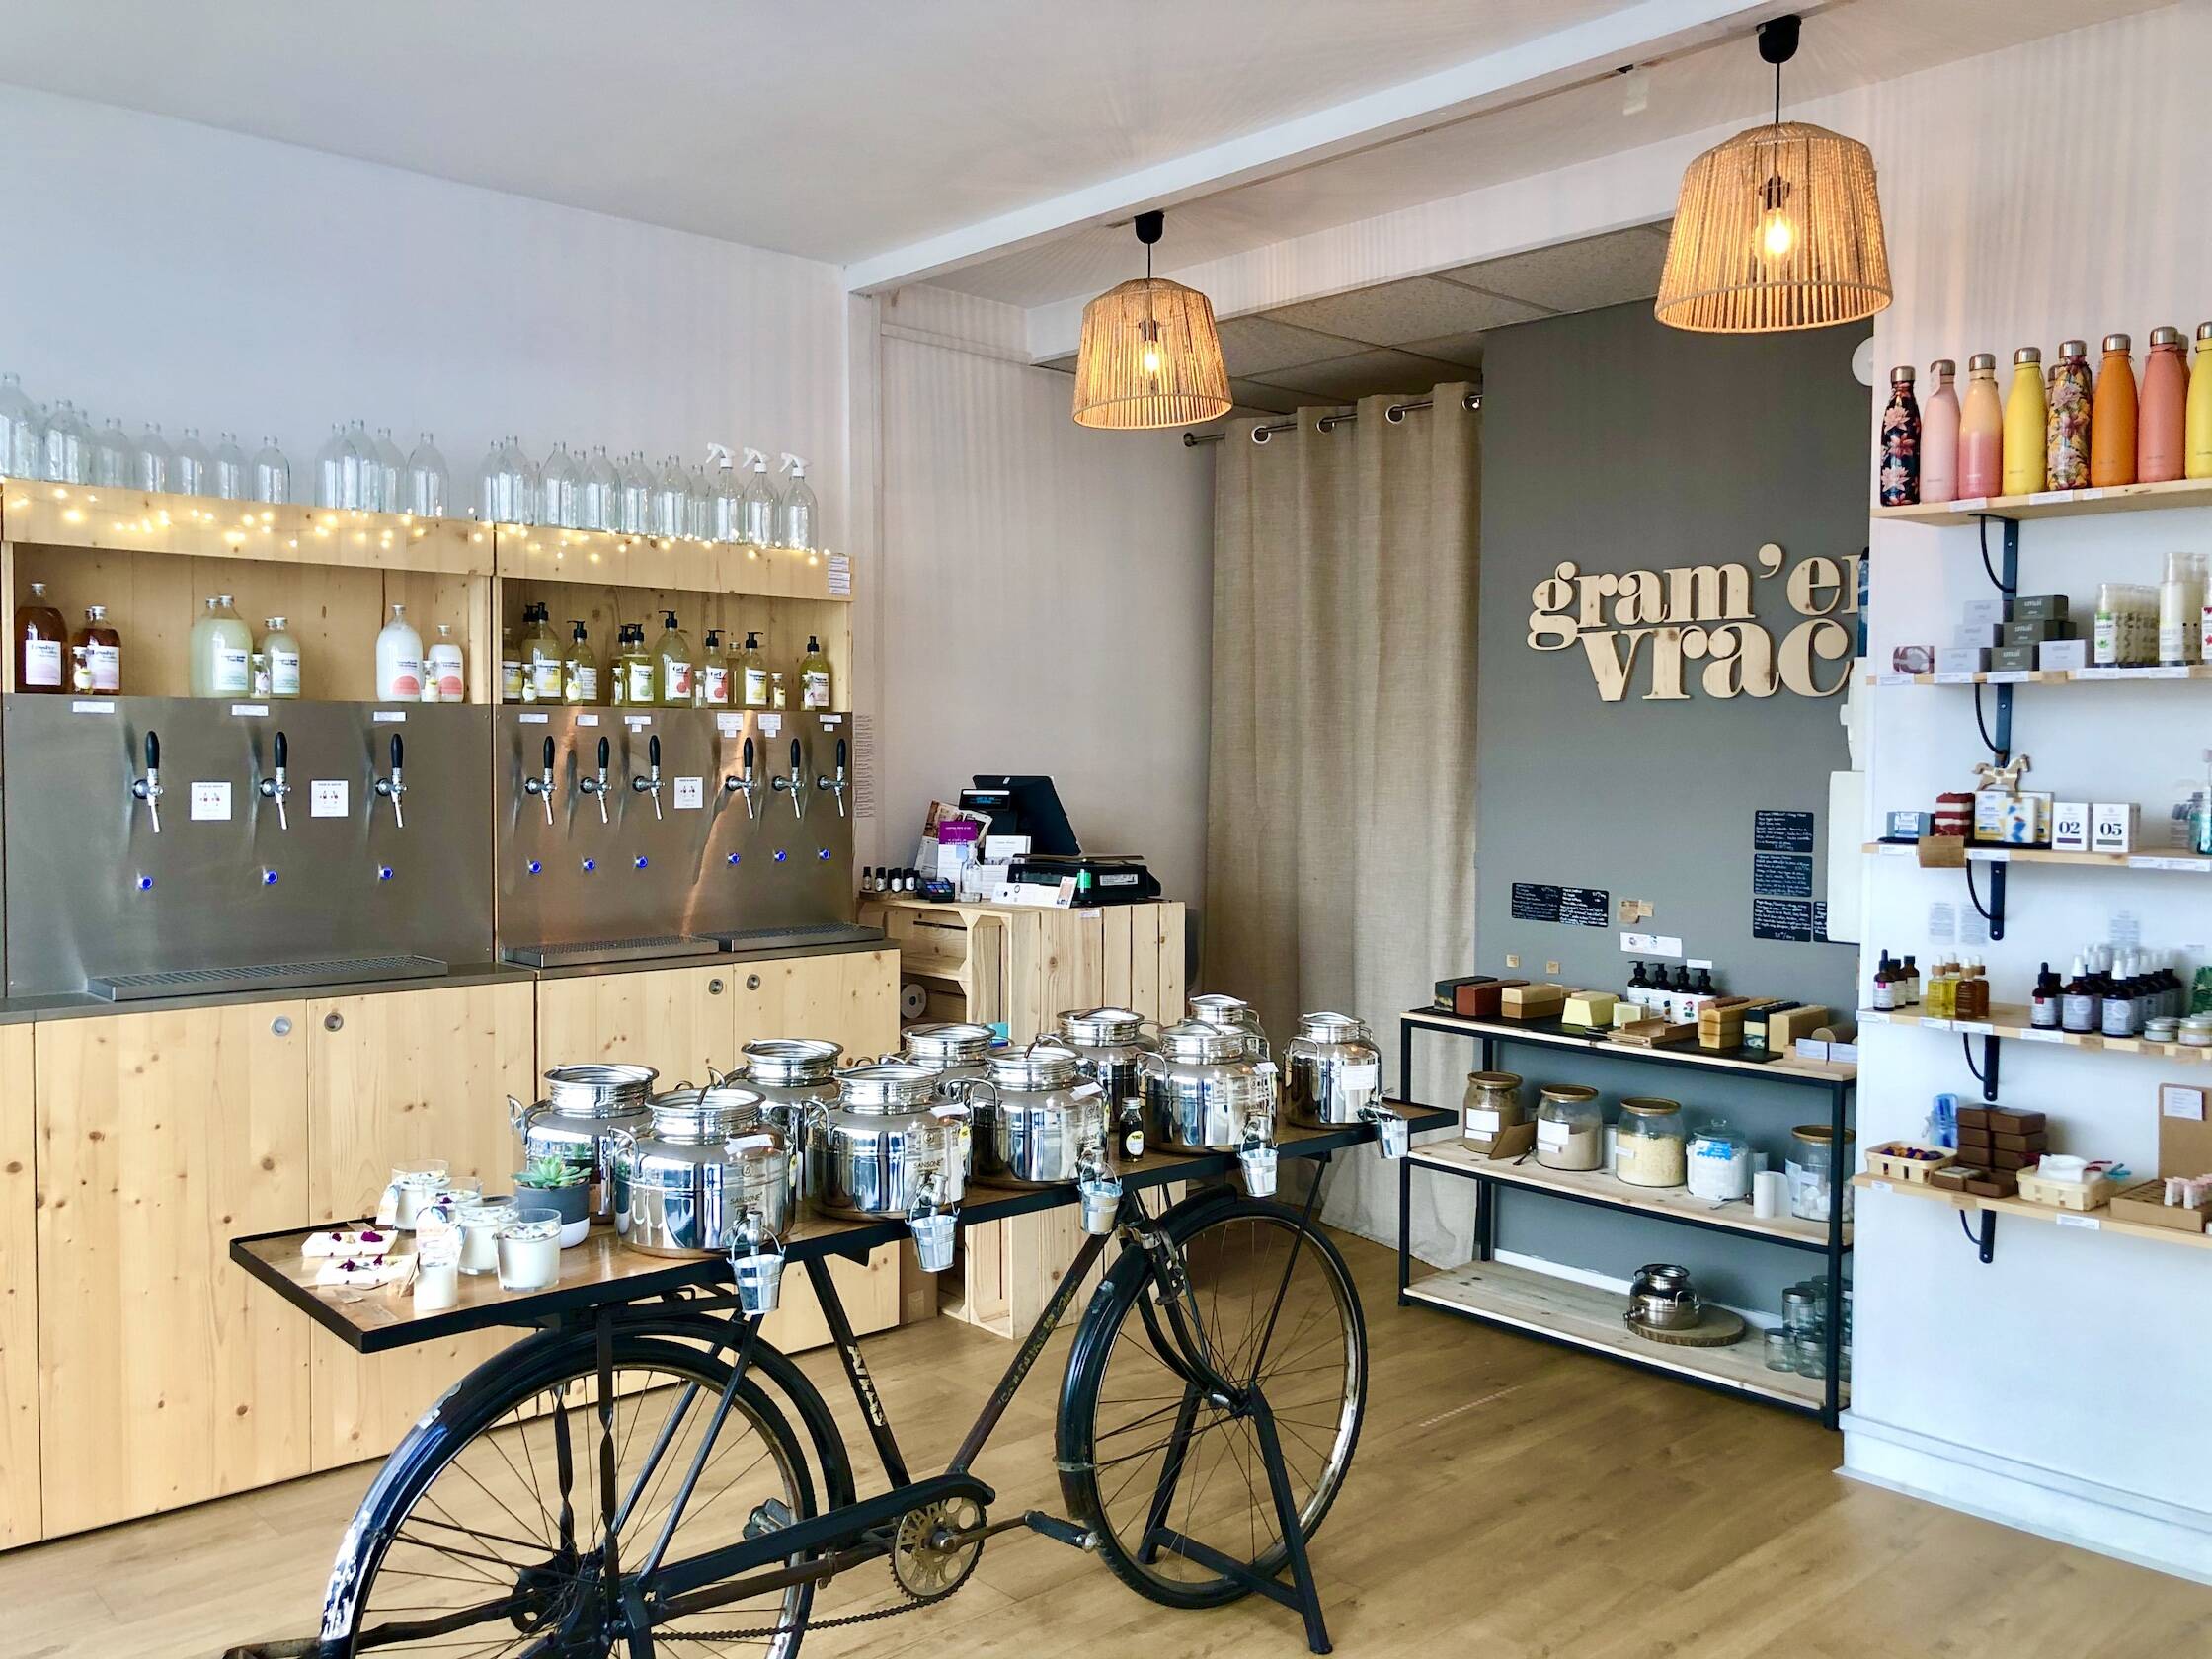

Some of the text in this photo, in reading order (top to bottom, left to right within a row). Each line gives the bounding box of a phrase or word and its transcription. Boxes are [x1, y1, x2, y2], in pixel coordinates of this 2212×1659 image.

[1577, 617, 1853, 701] vrac
[2058, 821, 2081, 835] 02
[2100, 822, 2123, 836] 05
